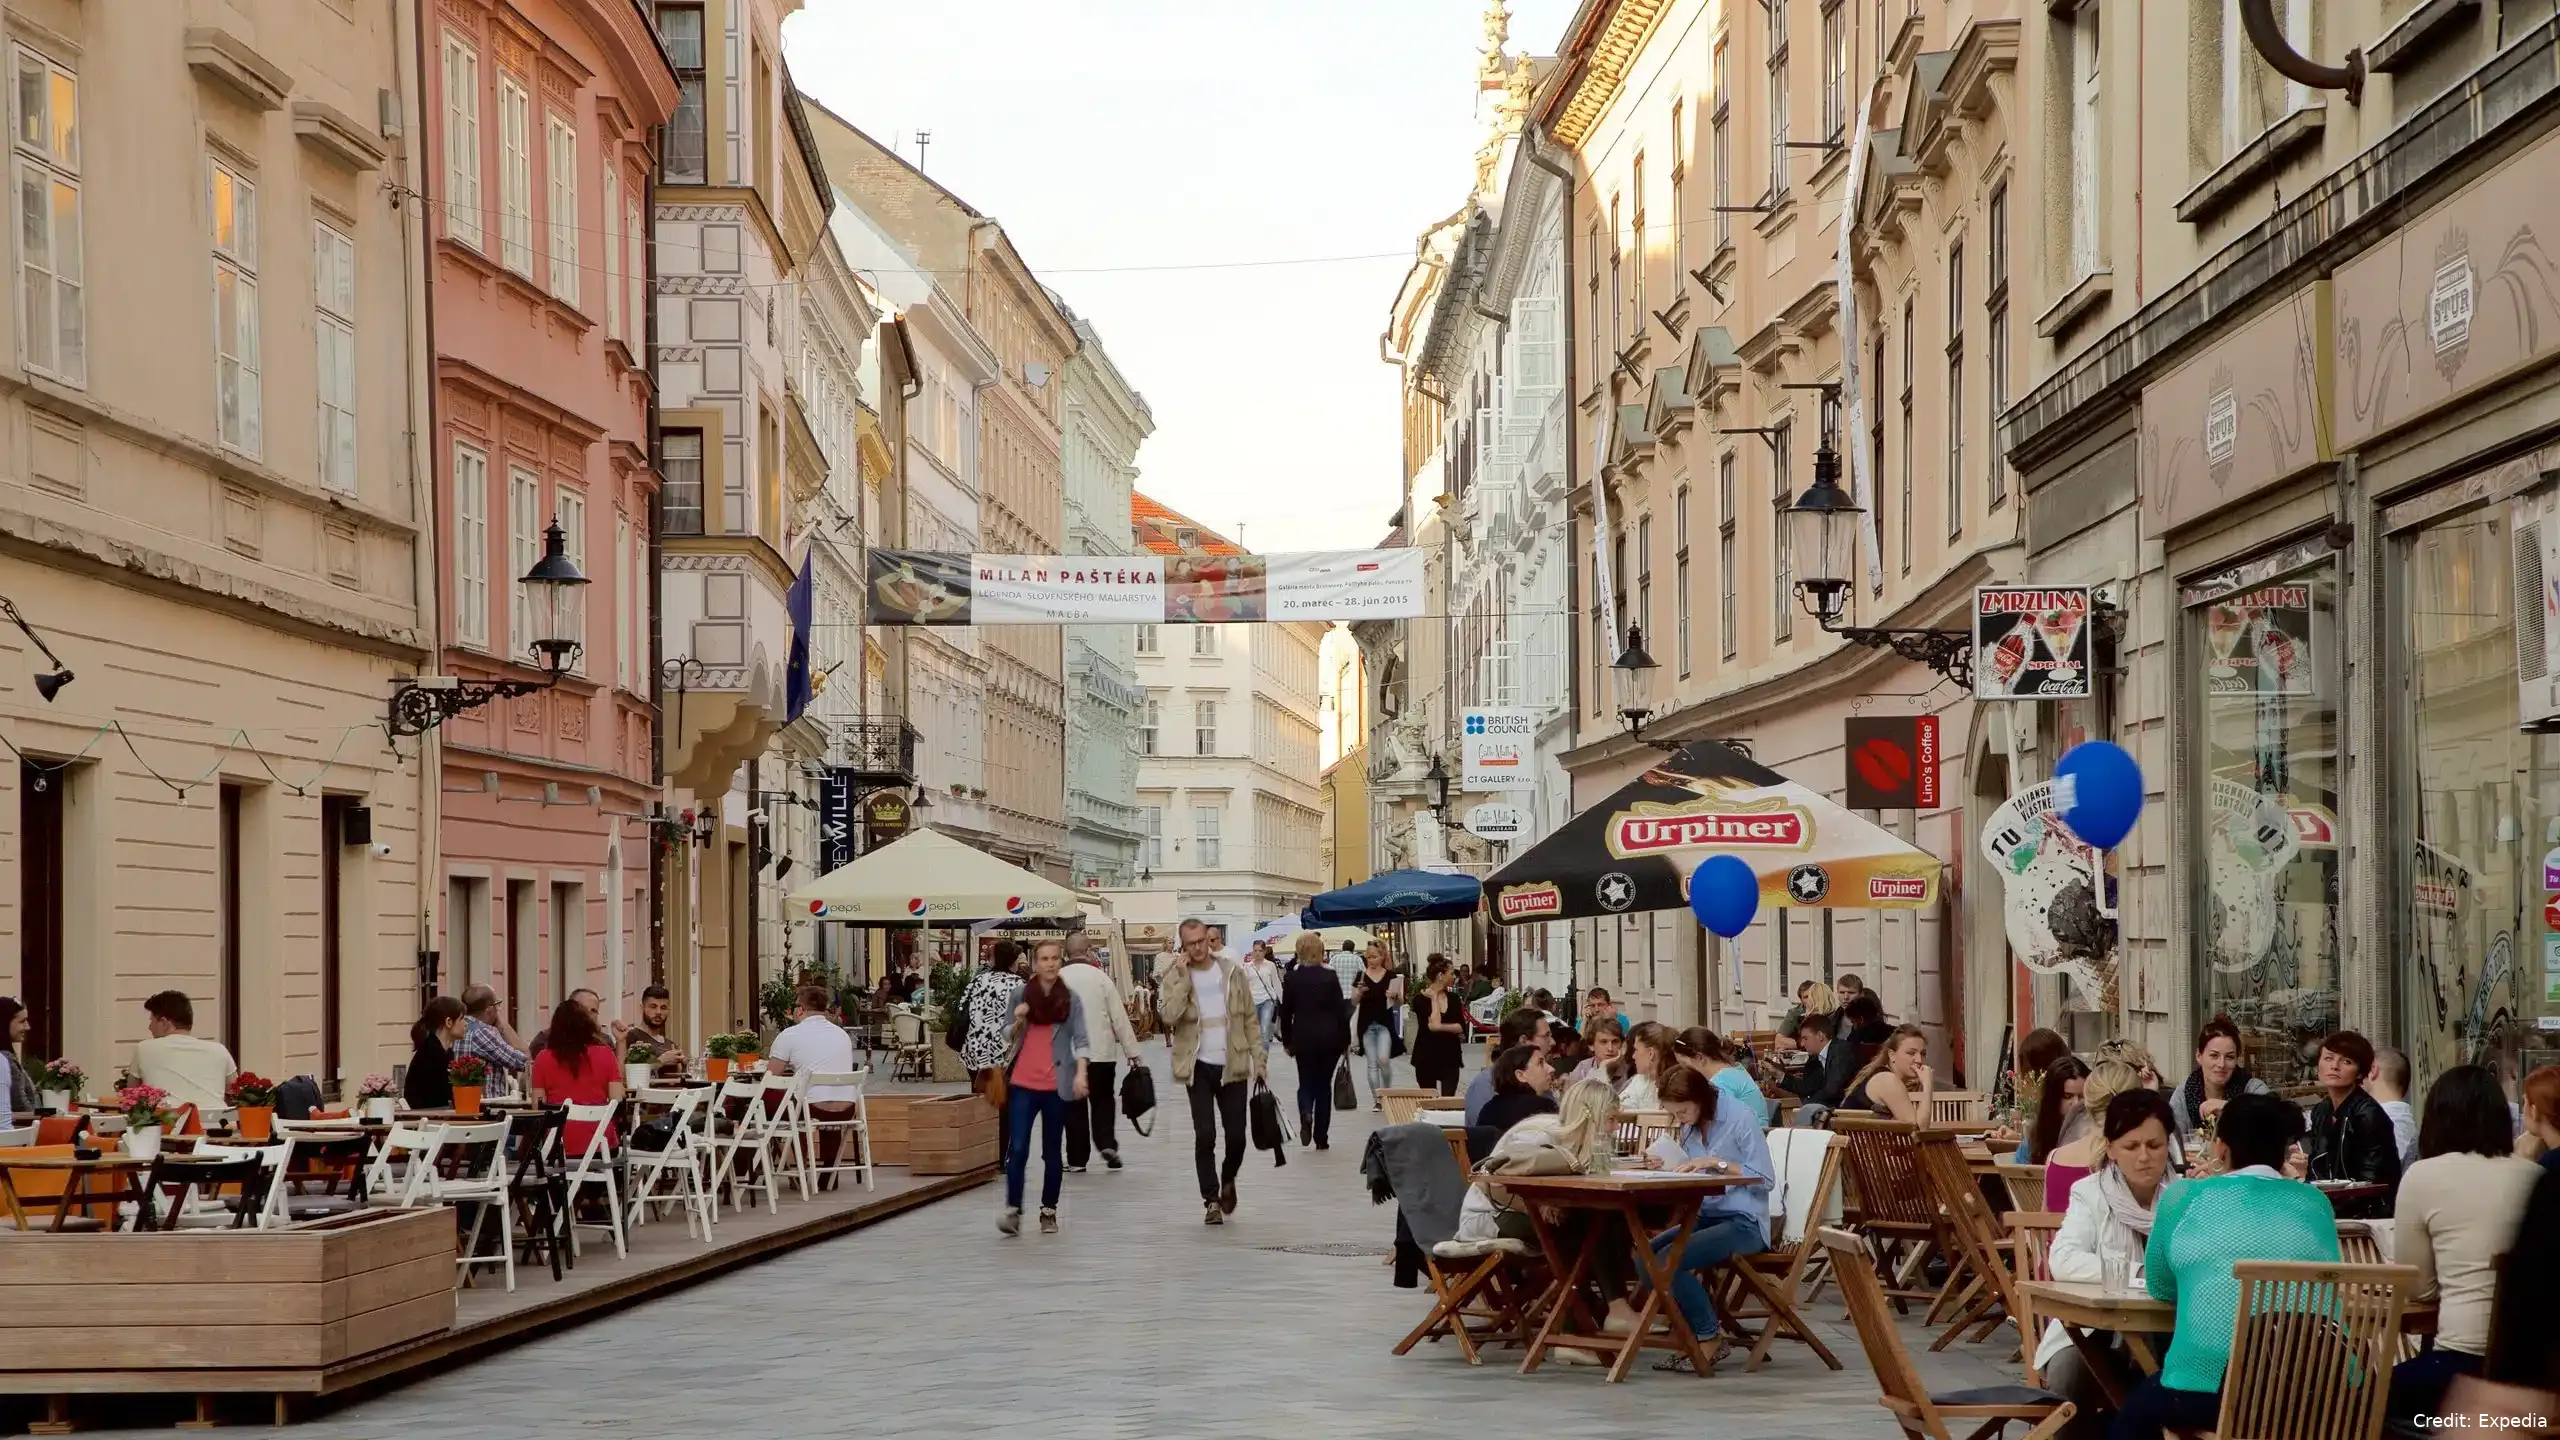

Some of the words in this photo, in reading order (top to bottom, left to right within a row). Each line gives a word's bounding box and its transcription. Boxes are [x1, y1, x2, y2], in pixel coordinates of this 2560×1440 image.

[979, 568, 1048, 582] MILAN
[1060, 568, 1157, 584] PAŠTÉKA
[978, 589, 1022, 599] LEGENDA
[1098, 593, 1157, 602] MALIARSTVA
[1283, 601, 1299, 609] 20.
[1302, 599, 1333, 608] marec
[1344, 597, 1361, 606] 28.
[1362, 596, 1380, 607] jún
[1382, 595, 1408, 605] 2015
[1981, 590, 2085, 613] ZMRZLINA
[2027, 660, 2084, 670] SPECIAL
[2038, 679, 2085, 694] Coca-Cola
[1488, 716, 1528, 724] BRITISH
[1487, 725, 1531, 734] COUNCIL
[1921, 724, 1932, 764] Coffee
[1480, 775, 1516, 783] GALLERY
[1922, 766, 1933, 803] Lino's
[2012, 786, 2052, 812] TALIANSK
[1627, 815, 1792, 844] Urpiner
[1991, 828, 2022, 857] TU
[1871, 881, 1923, 897] Urpiner
[829, 902, 862, 915] pepsi
[928, 900, 961, 913] pepsi
[1026, 898, 1058, 911] pepsi
[1504, 894, 1555, 911] Urpiner
